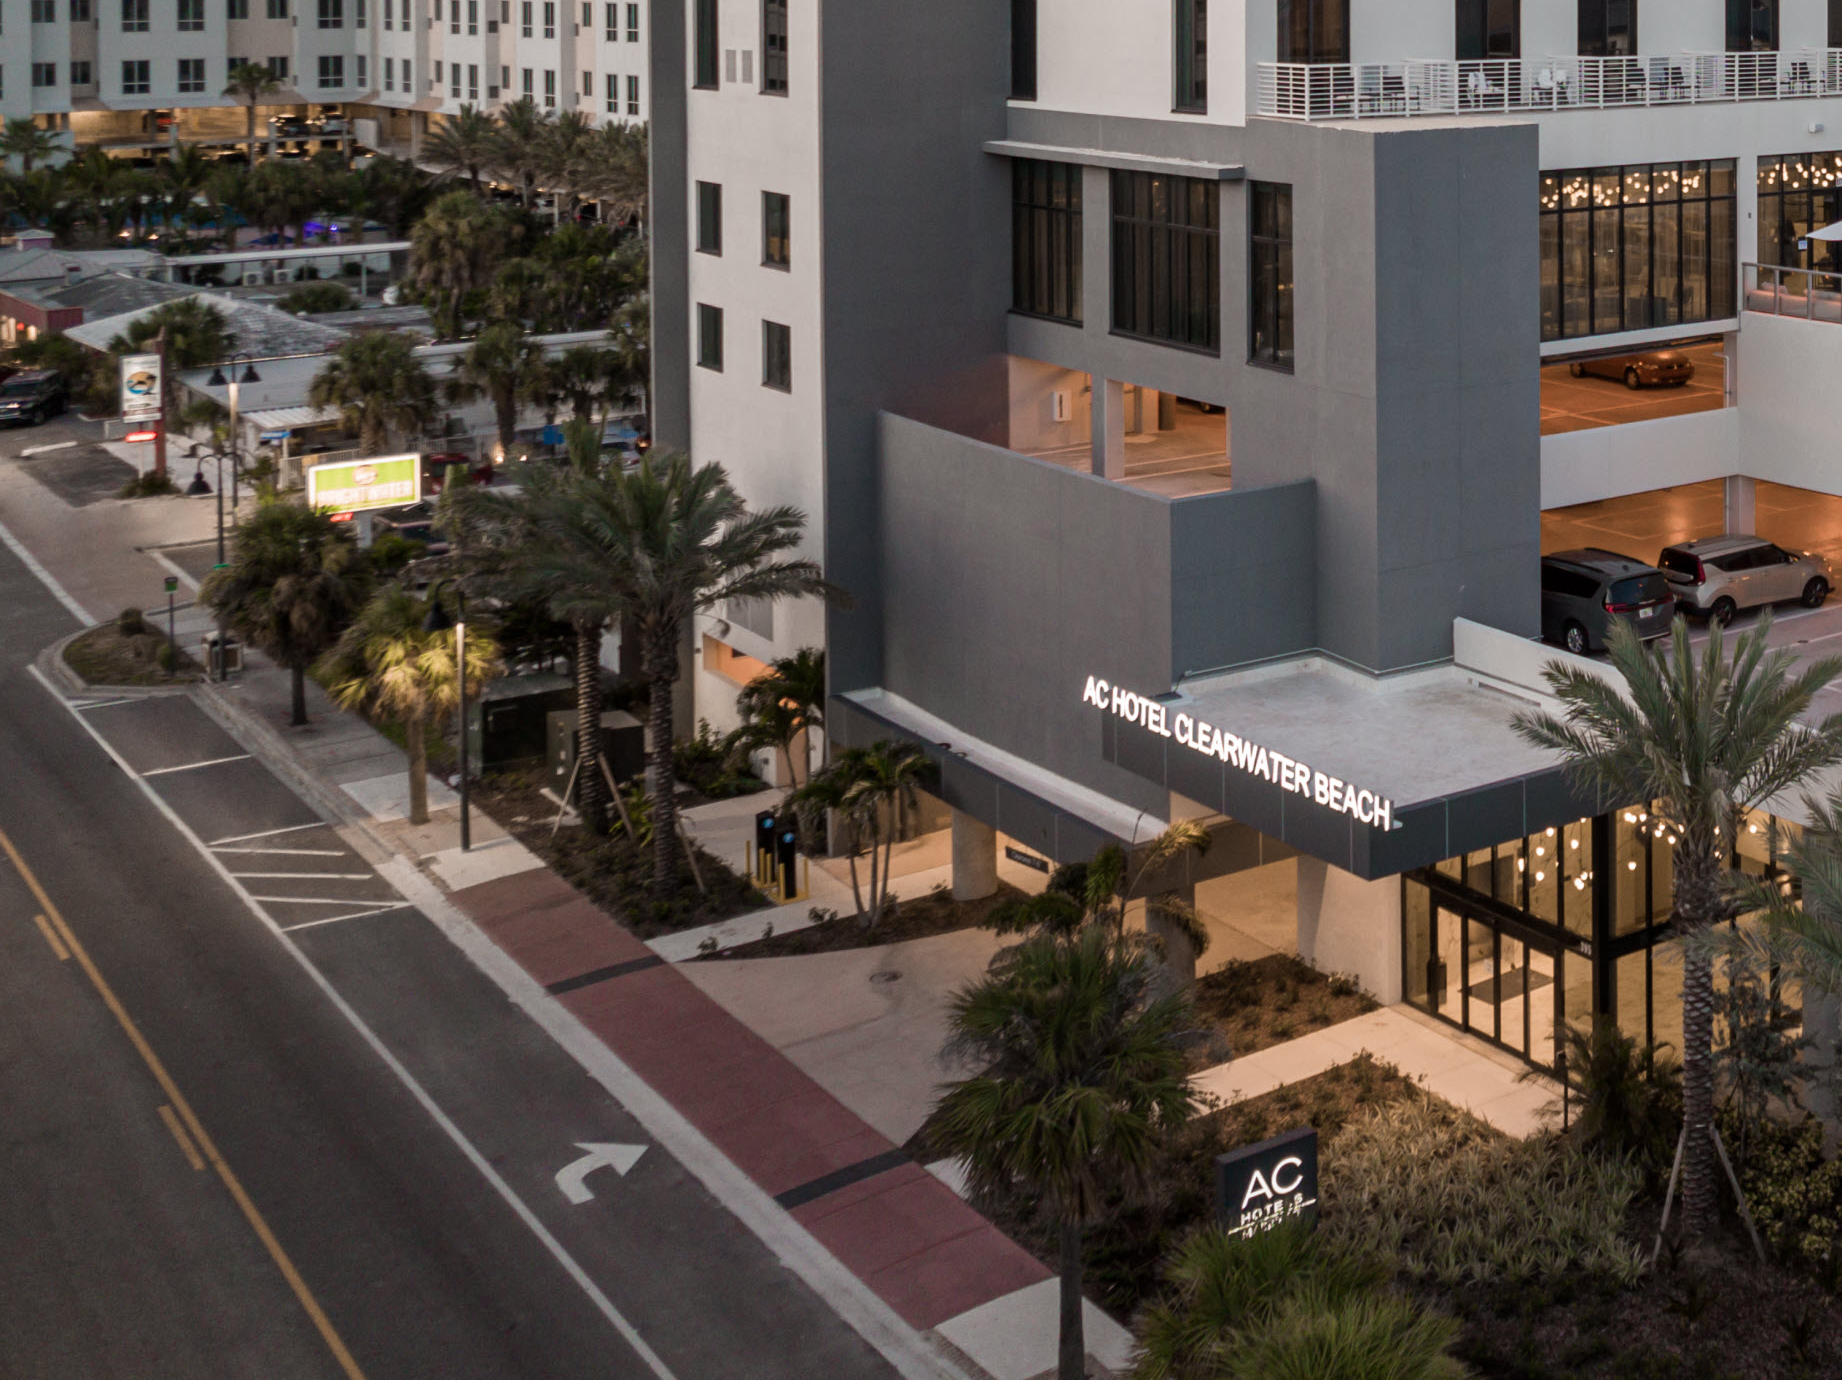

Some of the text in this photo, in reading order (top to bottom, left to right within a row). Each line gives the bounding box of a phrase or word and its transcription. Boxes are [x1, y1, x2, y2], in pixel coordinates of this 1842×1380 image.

[1083, 675, 1391, 832] AC HOTEL CLEARWATER BEACH
[1241, 1157, 1304, 1210] AC
[1241, 1193, 1304, 1227] HOTES
